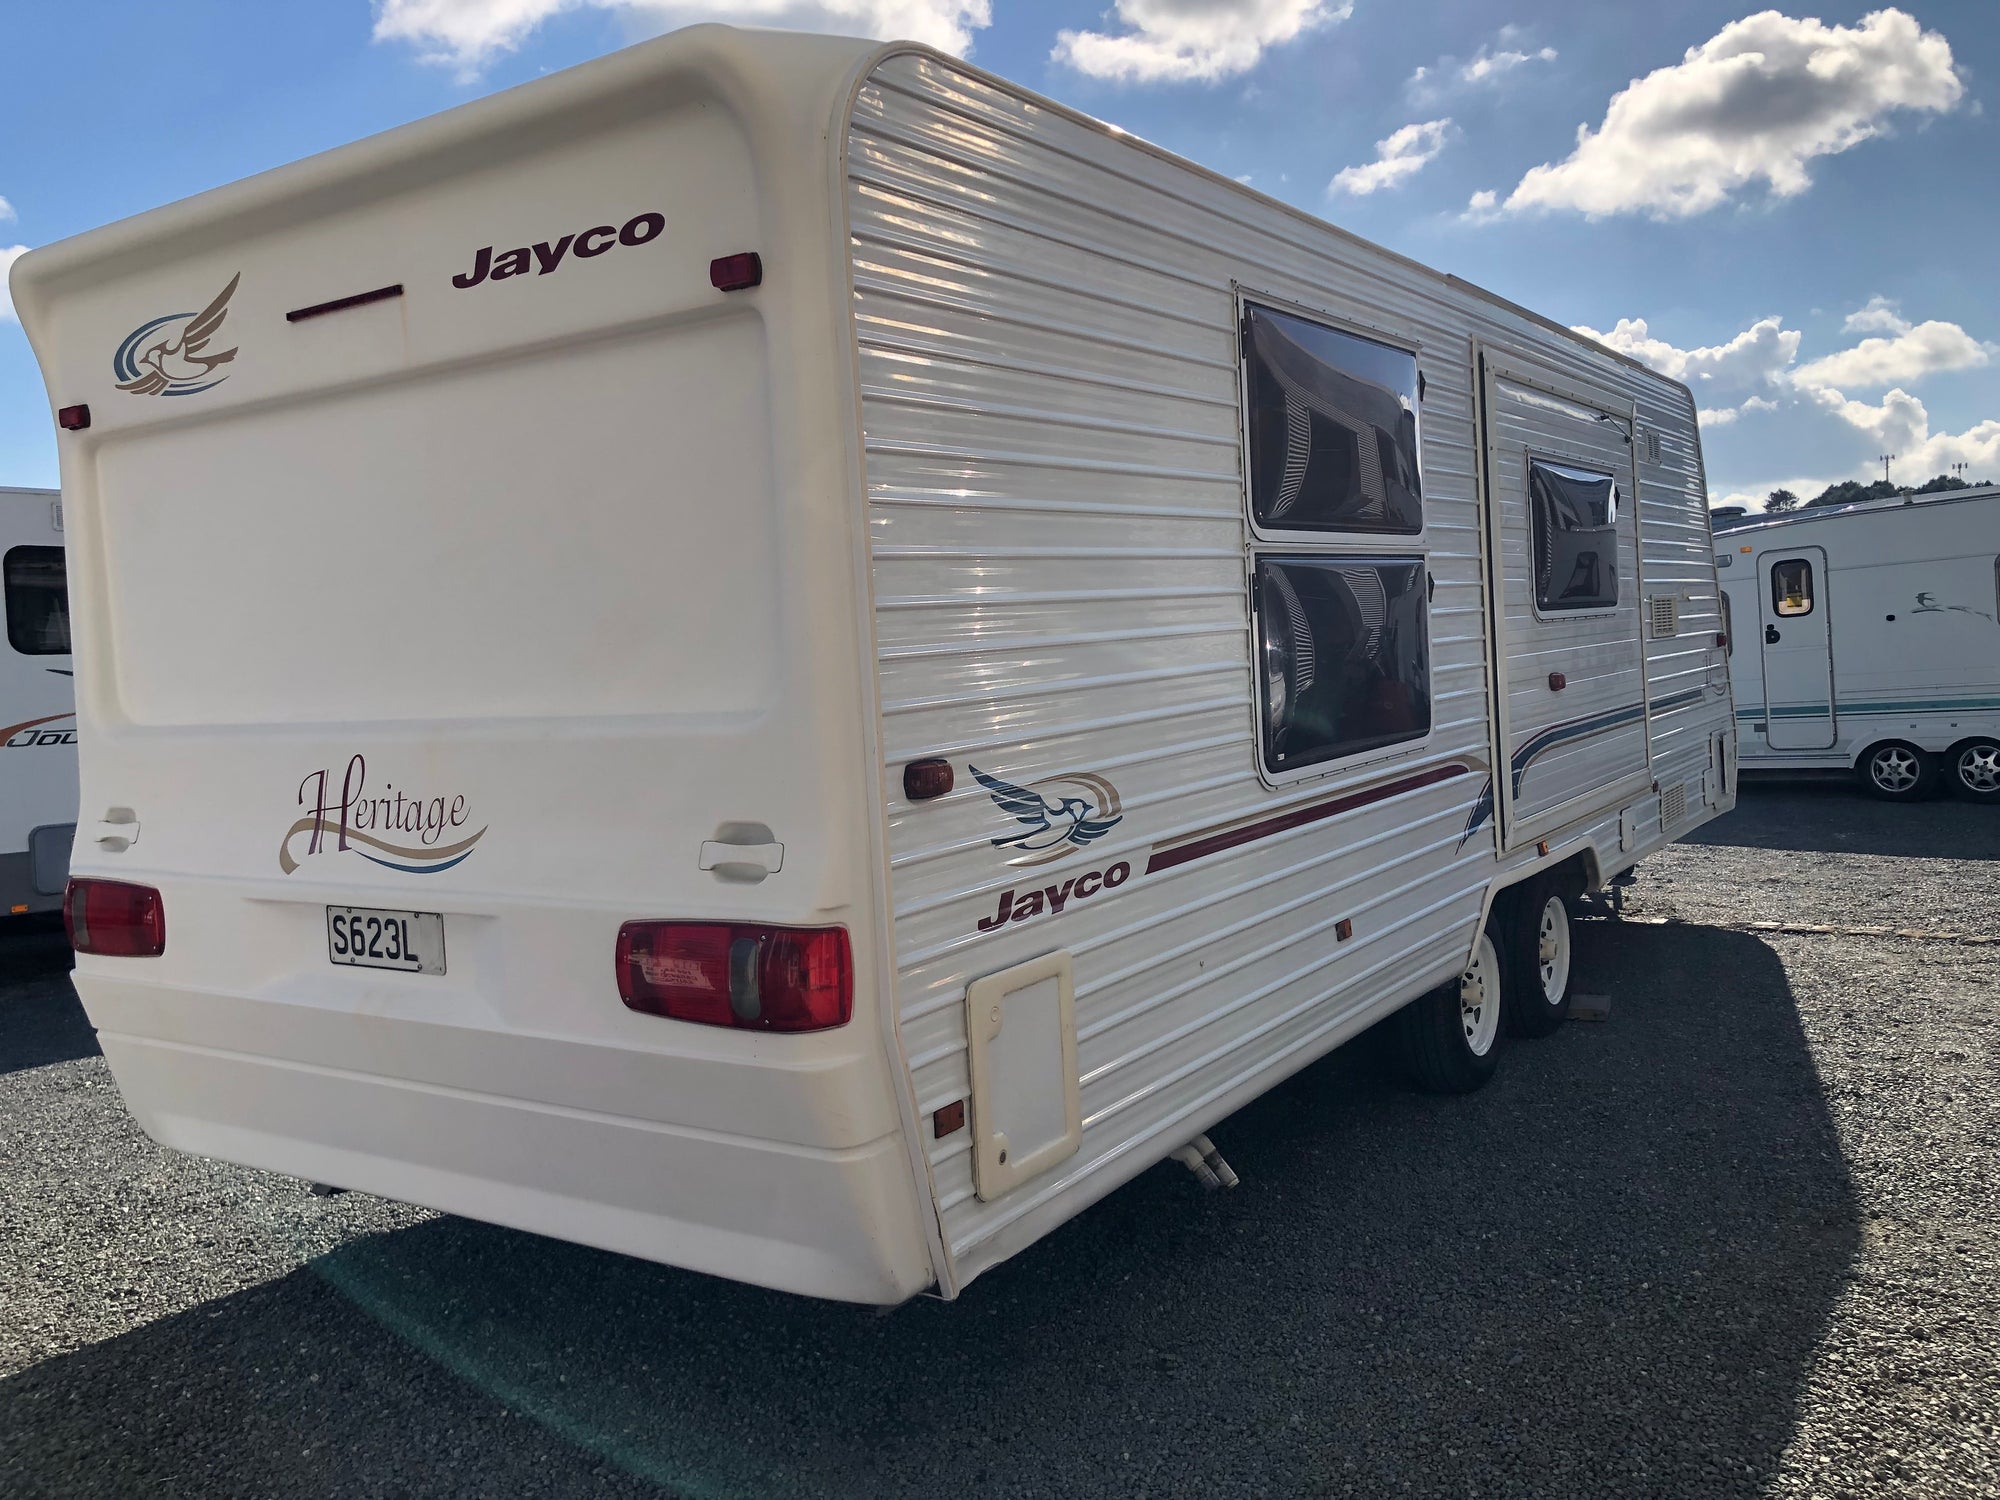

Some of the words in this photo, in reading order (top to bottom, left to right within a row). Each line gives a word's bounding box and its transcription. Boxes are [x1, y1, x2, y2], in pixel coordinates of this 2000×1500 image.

[452, 212, 665, 289] Jayco
[298, 753, 471, 855] Heritage
[977, 861, 1131, 932] Jayco
[332, 914, 419, 962] S623L
